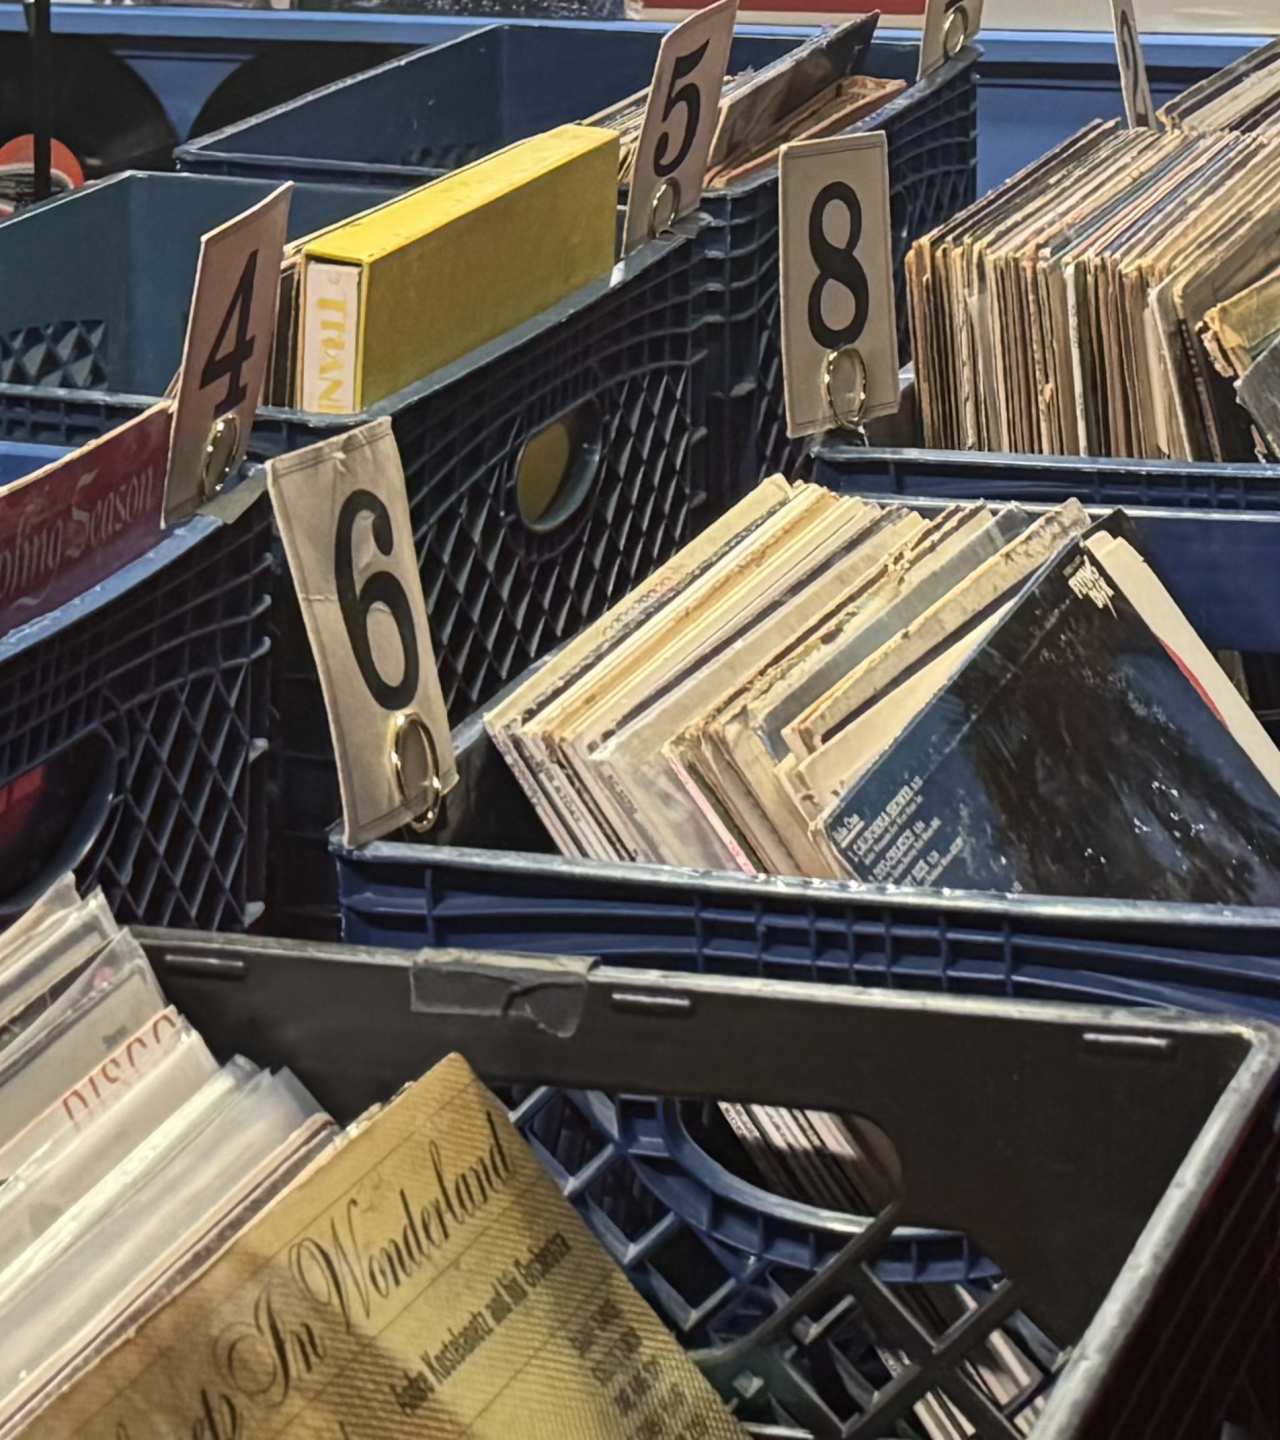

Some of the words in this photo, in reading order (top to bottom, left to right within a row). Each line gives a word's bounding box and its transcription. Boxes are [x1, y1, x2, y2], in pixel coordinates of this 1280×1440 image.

[651, 38, 711, 178] 5
[201, 249, 260, 415] 4
[807, 180, 869, 350] 8
[70, 463, 156, 552] Season
[335, 488, 420, 712] 6
[289, 1110, 516, 1330] Wonderland
